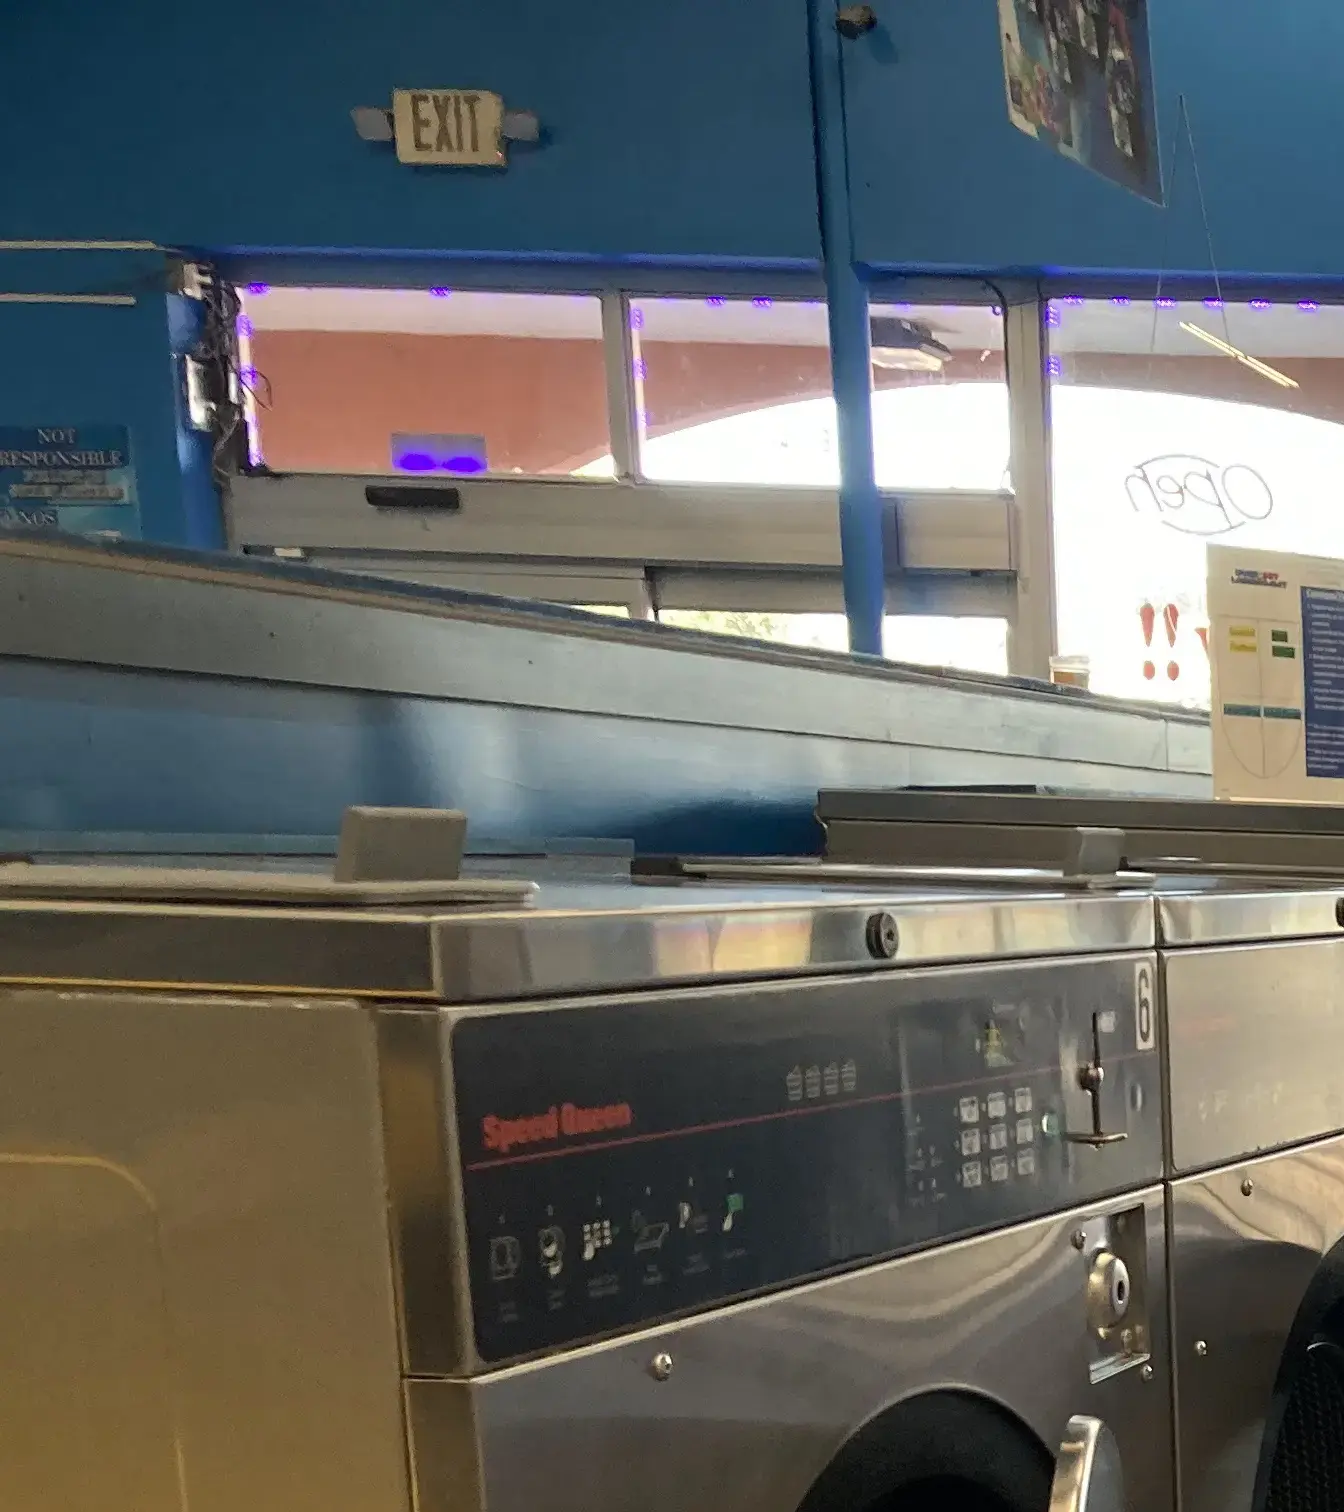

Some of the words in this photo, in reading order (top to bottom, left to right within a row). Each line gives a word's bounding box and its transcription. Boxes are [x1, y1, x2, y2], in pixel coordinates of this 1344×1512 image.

[411, 95, 480, 153] EXIT
[38, 428, 76, 444] NOT
[0, 450, 122, 466] RESPONSIBLE
[1139, 968, 1151, 1043] 6
